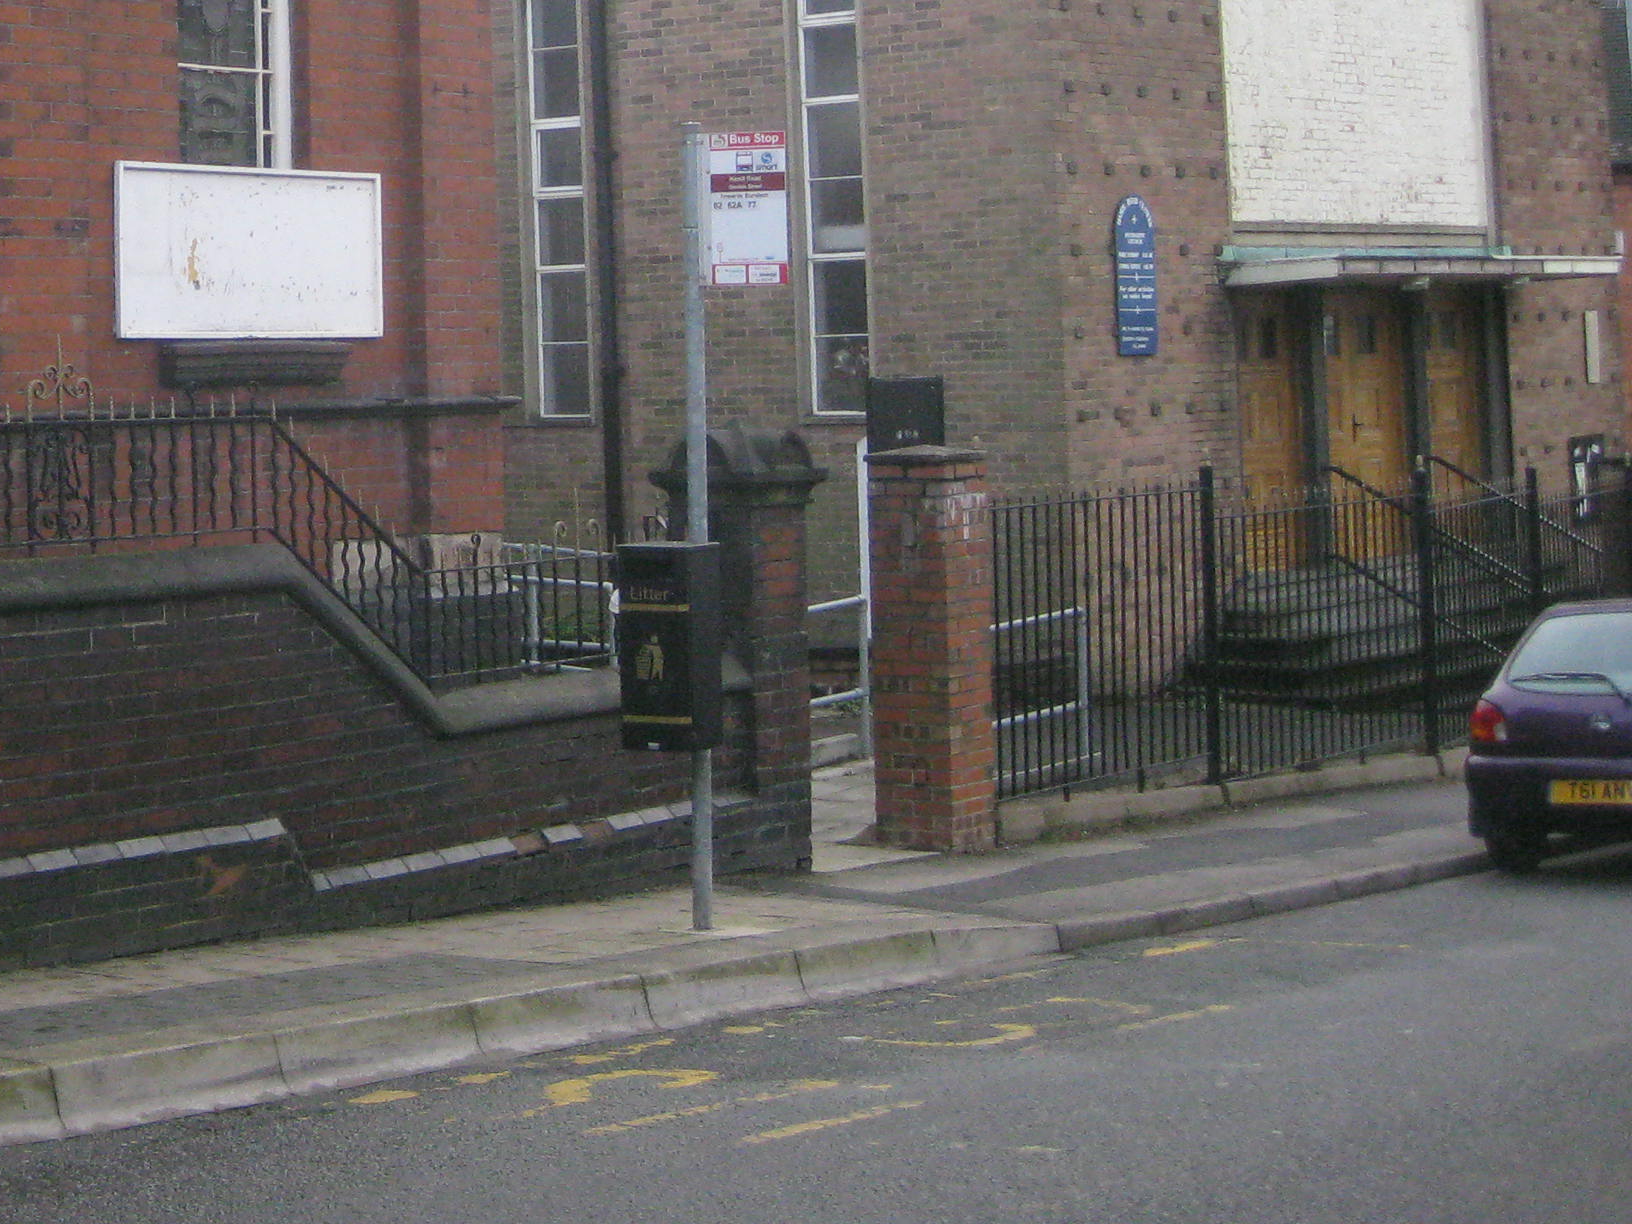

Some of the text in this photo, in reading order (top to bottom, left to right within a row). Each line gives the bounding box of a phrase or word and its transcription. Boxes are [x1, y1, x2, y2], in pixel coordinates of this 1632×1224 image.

[729, 133, 779, 145] Bus Stop
[629, 587, 670, 601] Litter
